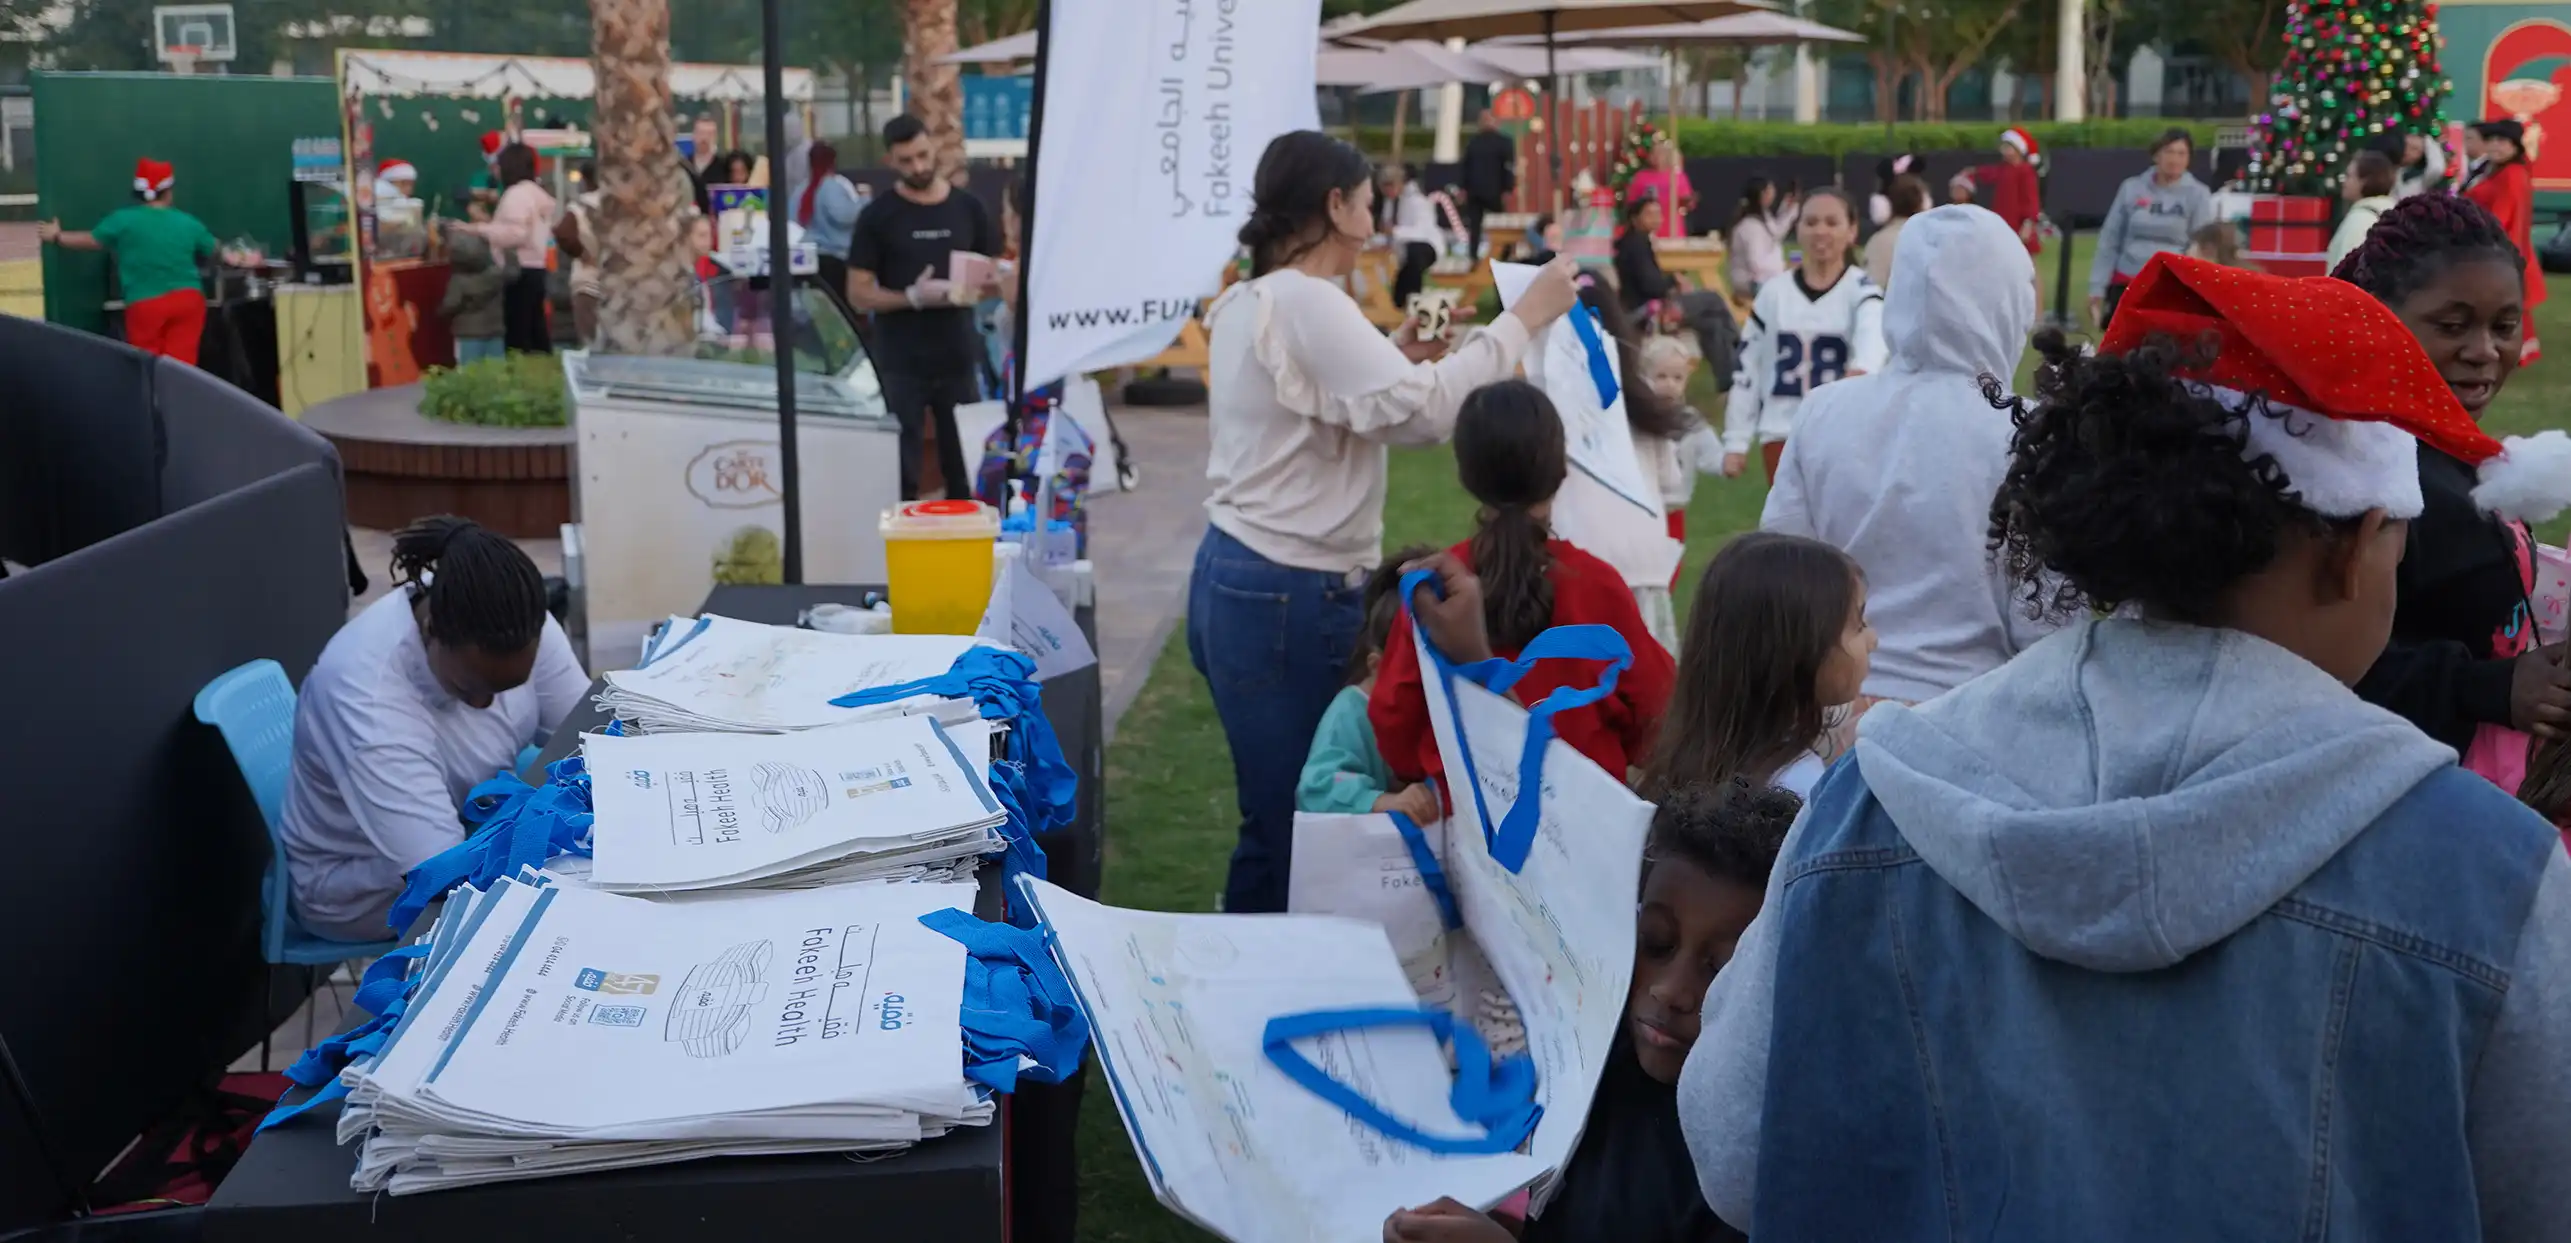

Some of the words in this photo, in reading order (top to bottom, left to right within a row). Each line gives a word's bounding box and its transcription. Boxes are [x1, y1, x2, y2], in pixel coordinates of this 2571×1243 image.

[1202, 102, 1231, 218] Fakeeh
[1771, 333, 1848, 397] 28
[702, 768, 732, 802] Health
[709, 805, 741, 844] Fakeeh
[793, 927, 833, 985] Fakeeh
[774, 987, 819, 1047] Health
